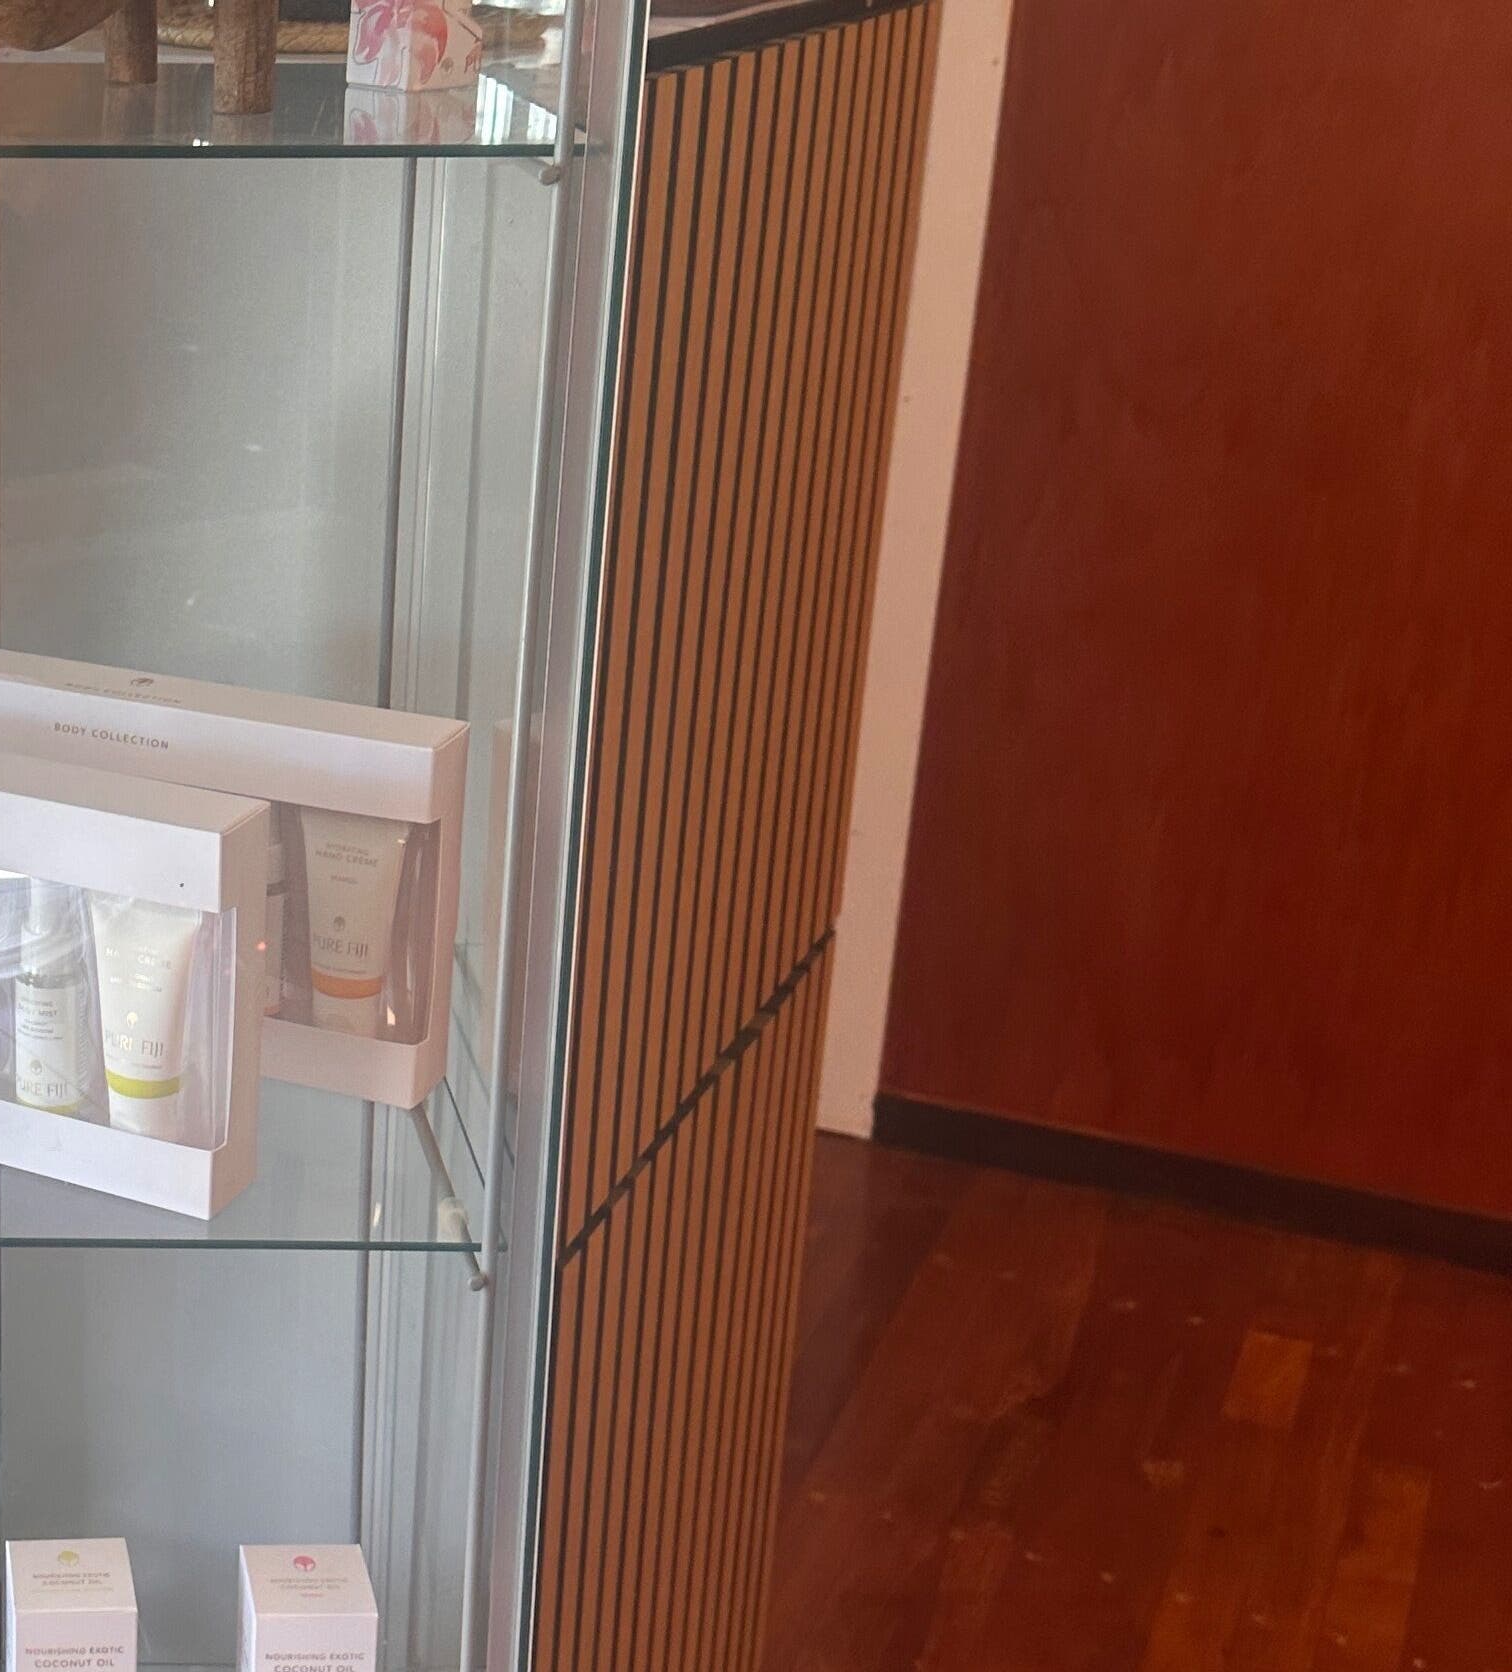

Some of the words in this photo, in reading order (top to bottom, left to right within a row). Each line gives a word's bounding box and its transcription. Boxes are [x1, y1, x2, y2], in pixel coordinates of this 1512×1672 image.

[53, 721, 87, 737] BODY
[91, 728, 169, 750] COLLECTION
[346, 941, 369, 959] FIJI
[141, 1040, 165, 1059] FIJI
[47, 1082, 67, 1099] FIJI
[25, 1647, 87, 1656] NOURISHING
[89, 1645, 125, 1655] EXOTIC
[264, 1652, 327, 1661] NOURISHING
[329, 1652, 366, 1661] EXOTIC
[33, 1658, 92, 1669] COCONUT
[96, 1658, 116, 1668] OIL
[273, 1664, 333, 1672] COCONUT
[335, 1664, 357, 1672] OIL
